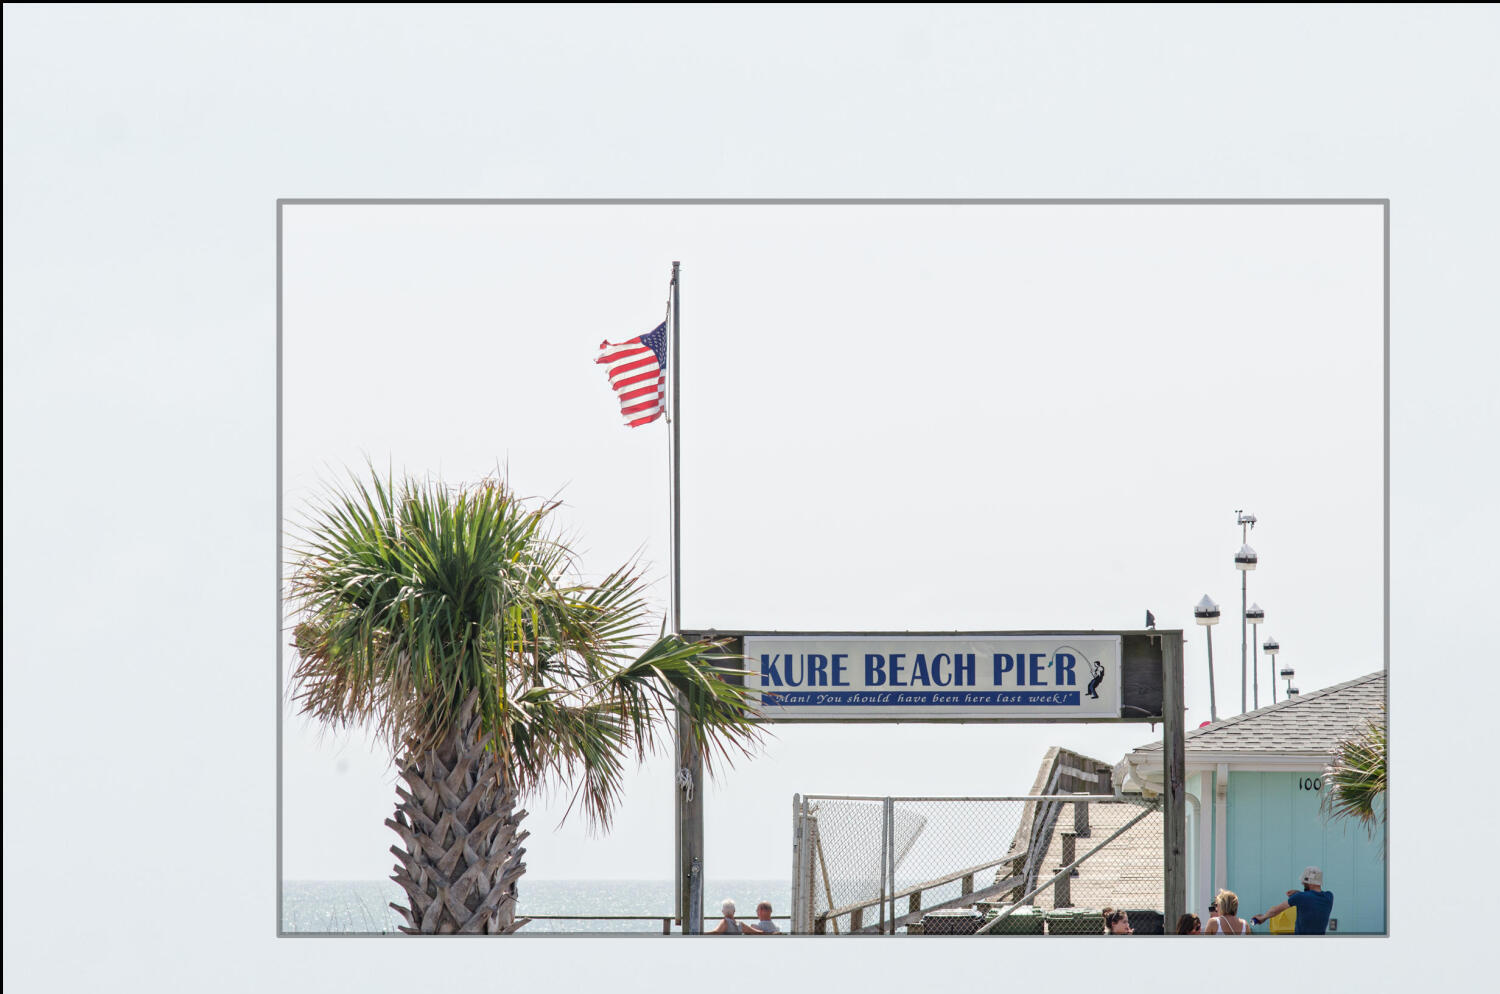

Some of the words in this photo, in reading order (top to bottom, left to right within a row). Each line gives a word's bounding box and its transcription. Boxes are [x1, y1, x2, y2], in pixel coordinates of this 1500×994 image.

[761, 654, 850, 687] KURE
[865, 653, 975, 687] BEACH
[994, 653, 1076, 686] PIER
[816, 694, 846, 705] You
[848, 693, 891, 703] should
[898, 694, 926, 703] have
[932, 694, 959, 703] been
[964, 694, 991, 703] here
[996, 694, 1022, 703] last
[1299, 777, 1321, 791] 100
